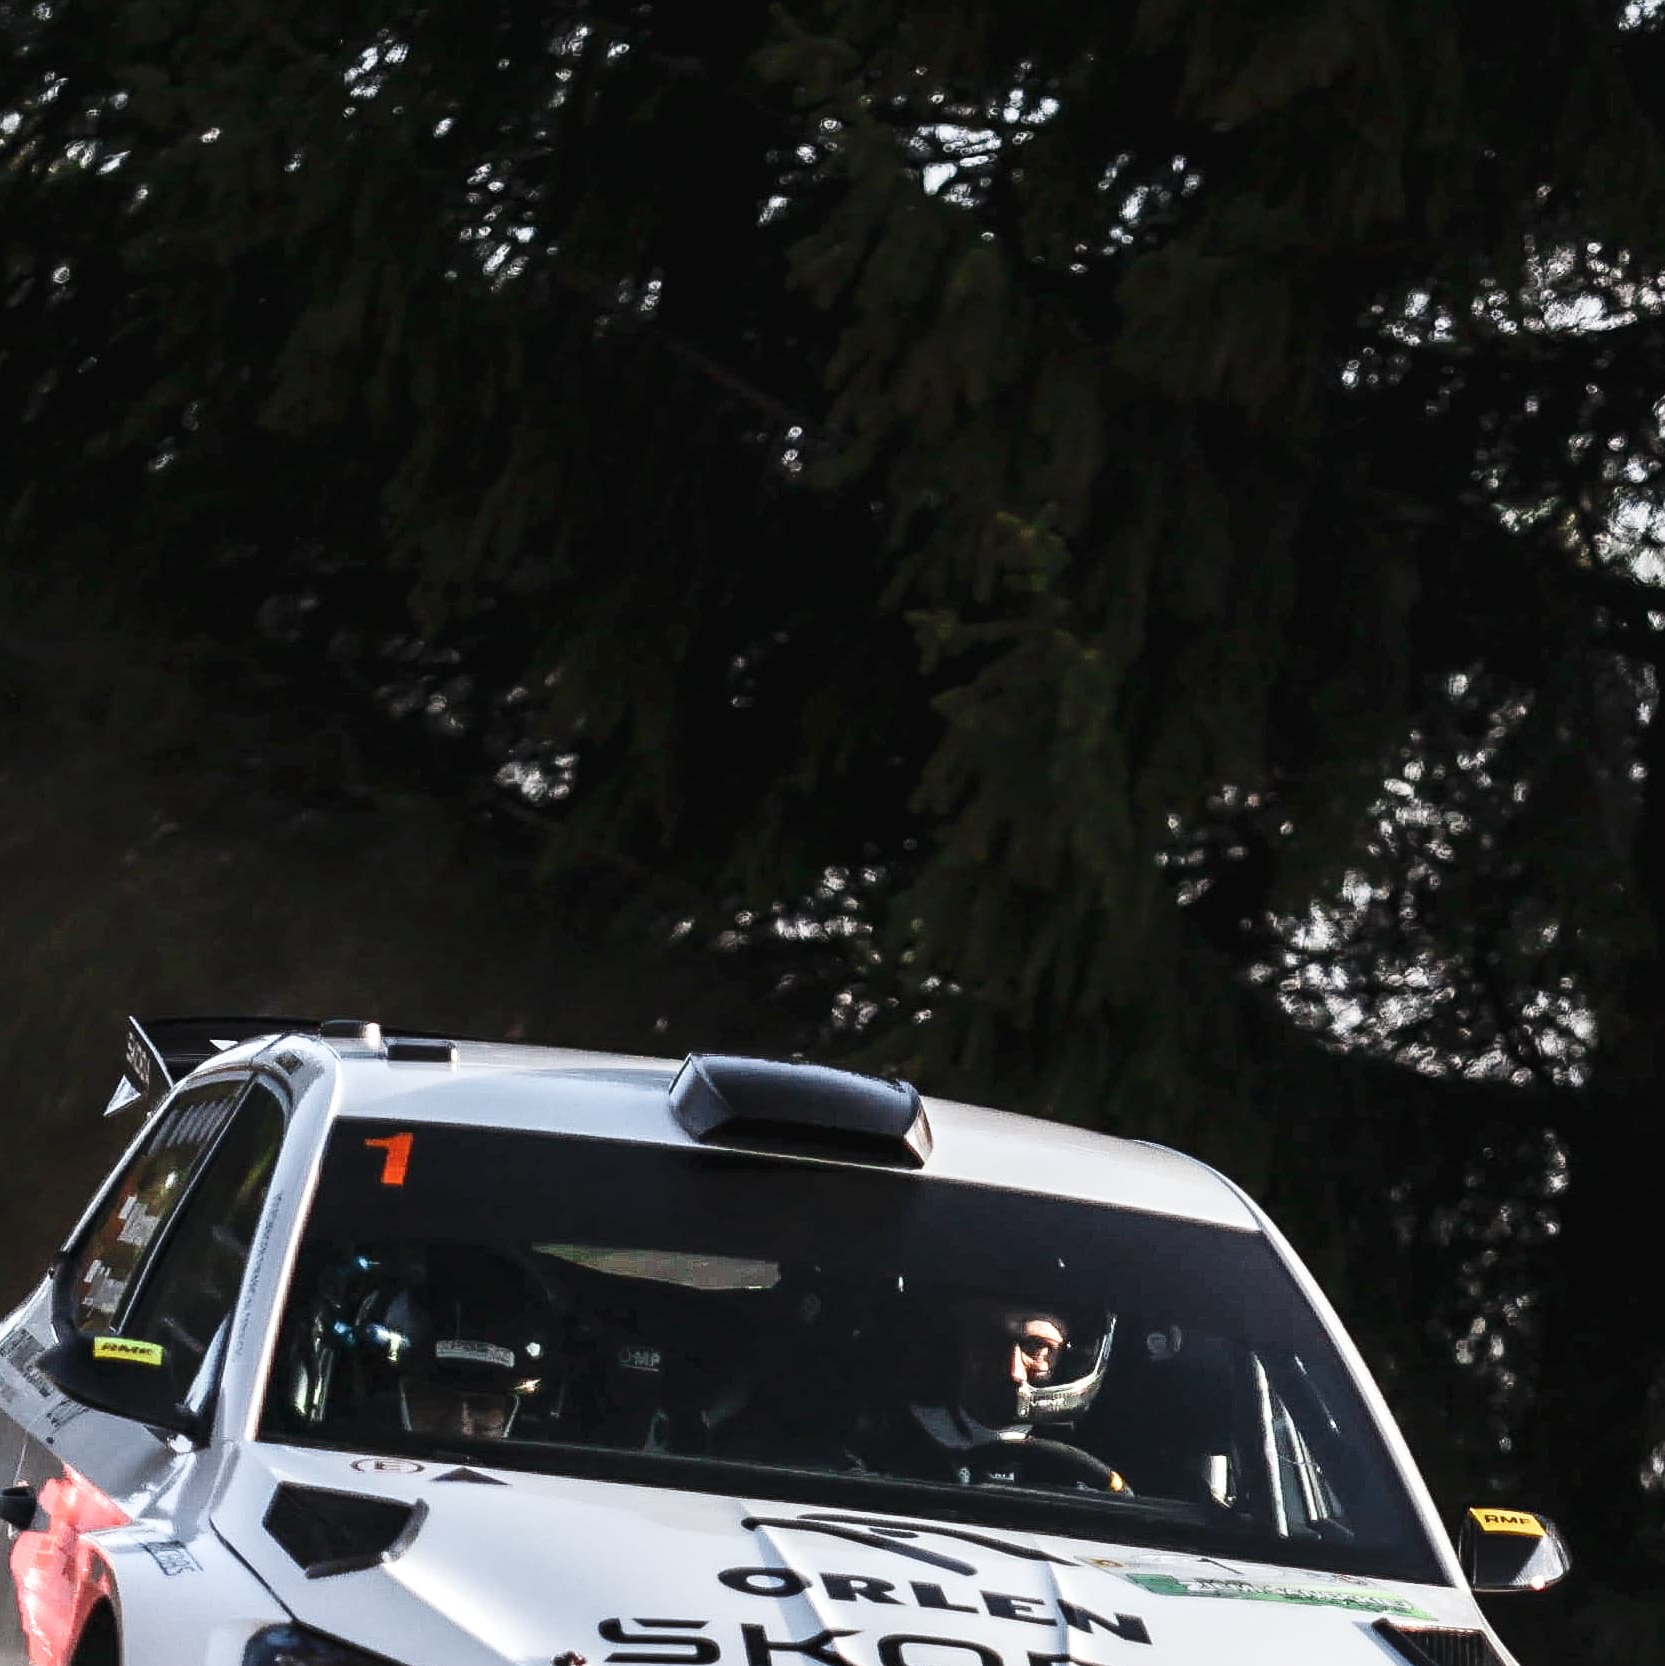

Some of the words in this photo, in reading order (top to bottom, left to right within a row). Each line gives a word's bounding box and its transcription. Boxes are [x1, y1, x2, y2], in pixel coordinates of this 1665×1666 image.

[364, 1132, 414, 1185] 1
[1484, 1514, 1531, 1525] RMF
[717, 1566, 1152, 1645] ORLEN
